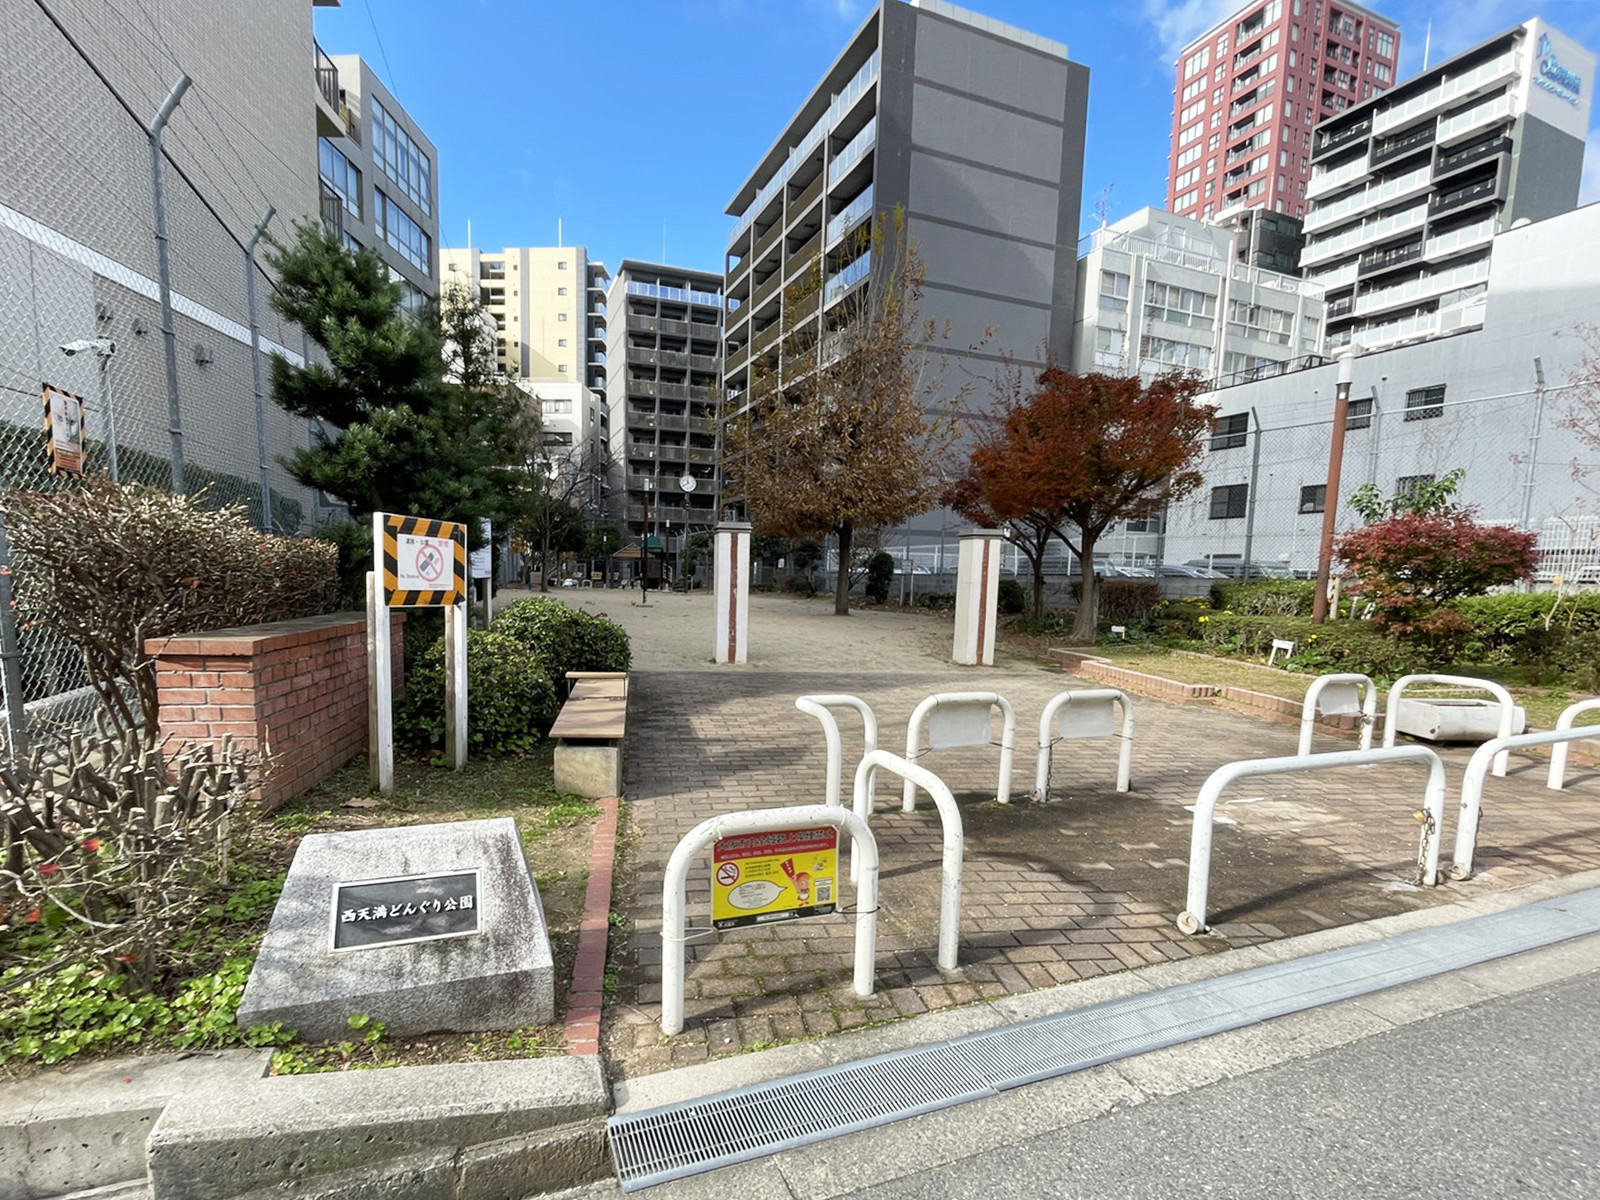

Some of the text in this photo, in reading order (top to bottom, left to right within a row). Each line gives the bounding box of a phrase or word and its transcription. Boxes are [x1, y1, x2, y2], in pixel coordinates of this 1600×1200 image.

[341, 895, 473, 922] 西天満どんぐり公園
